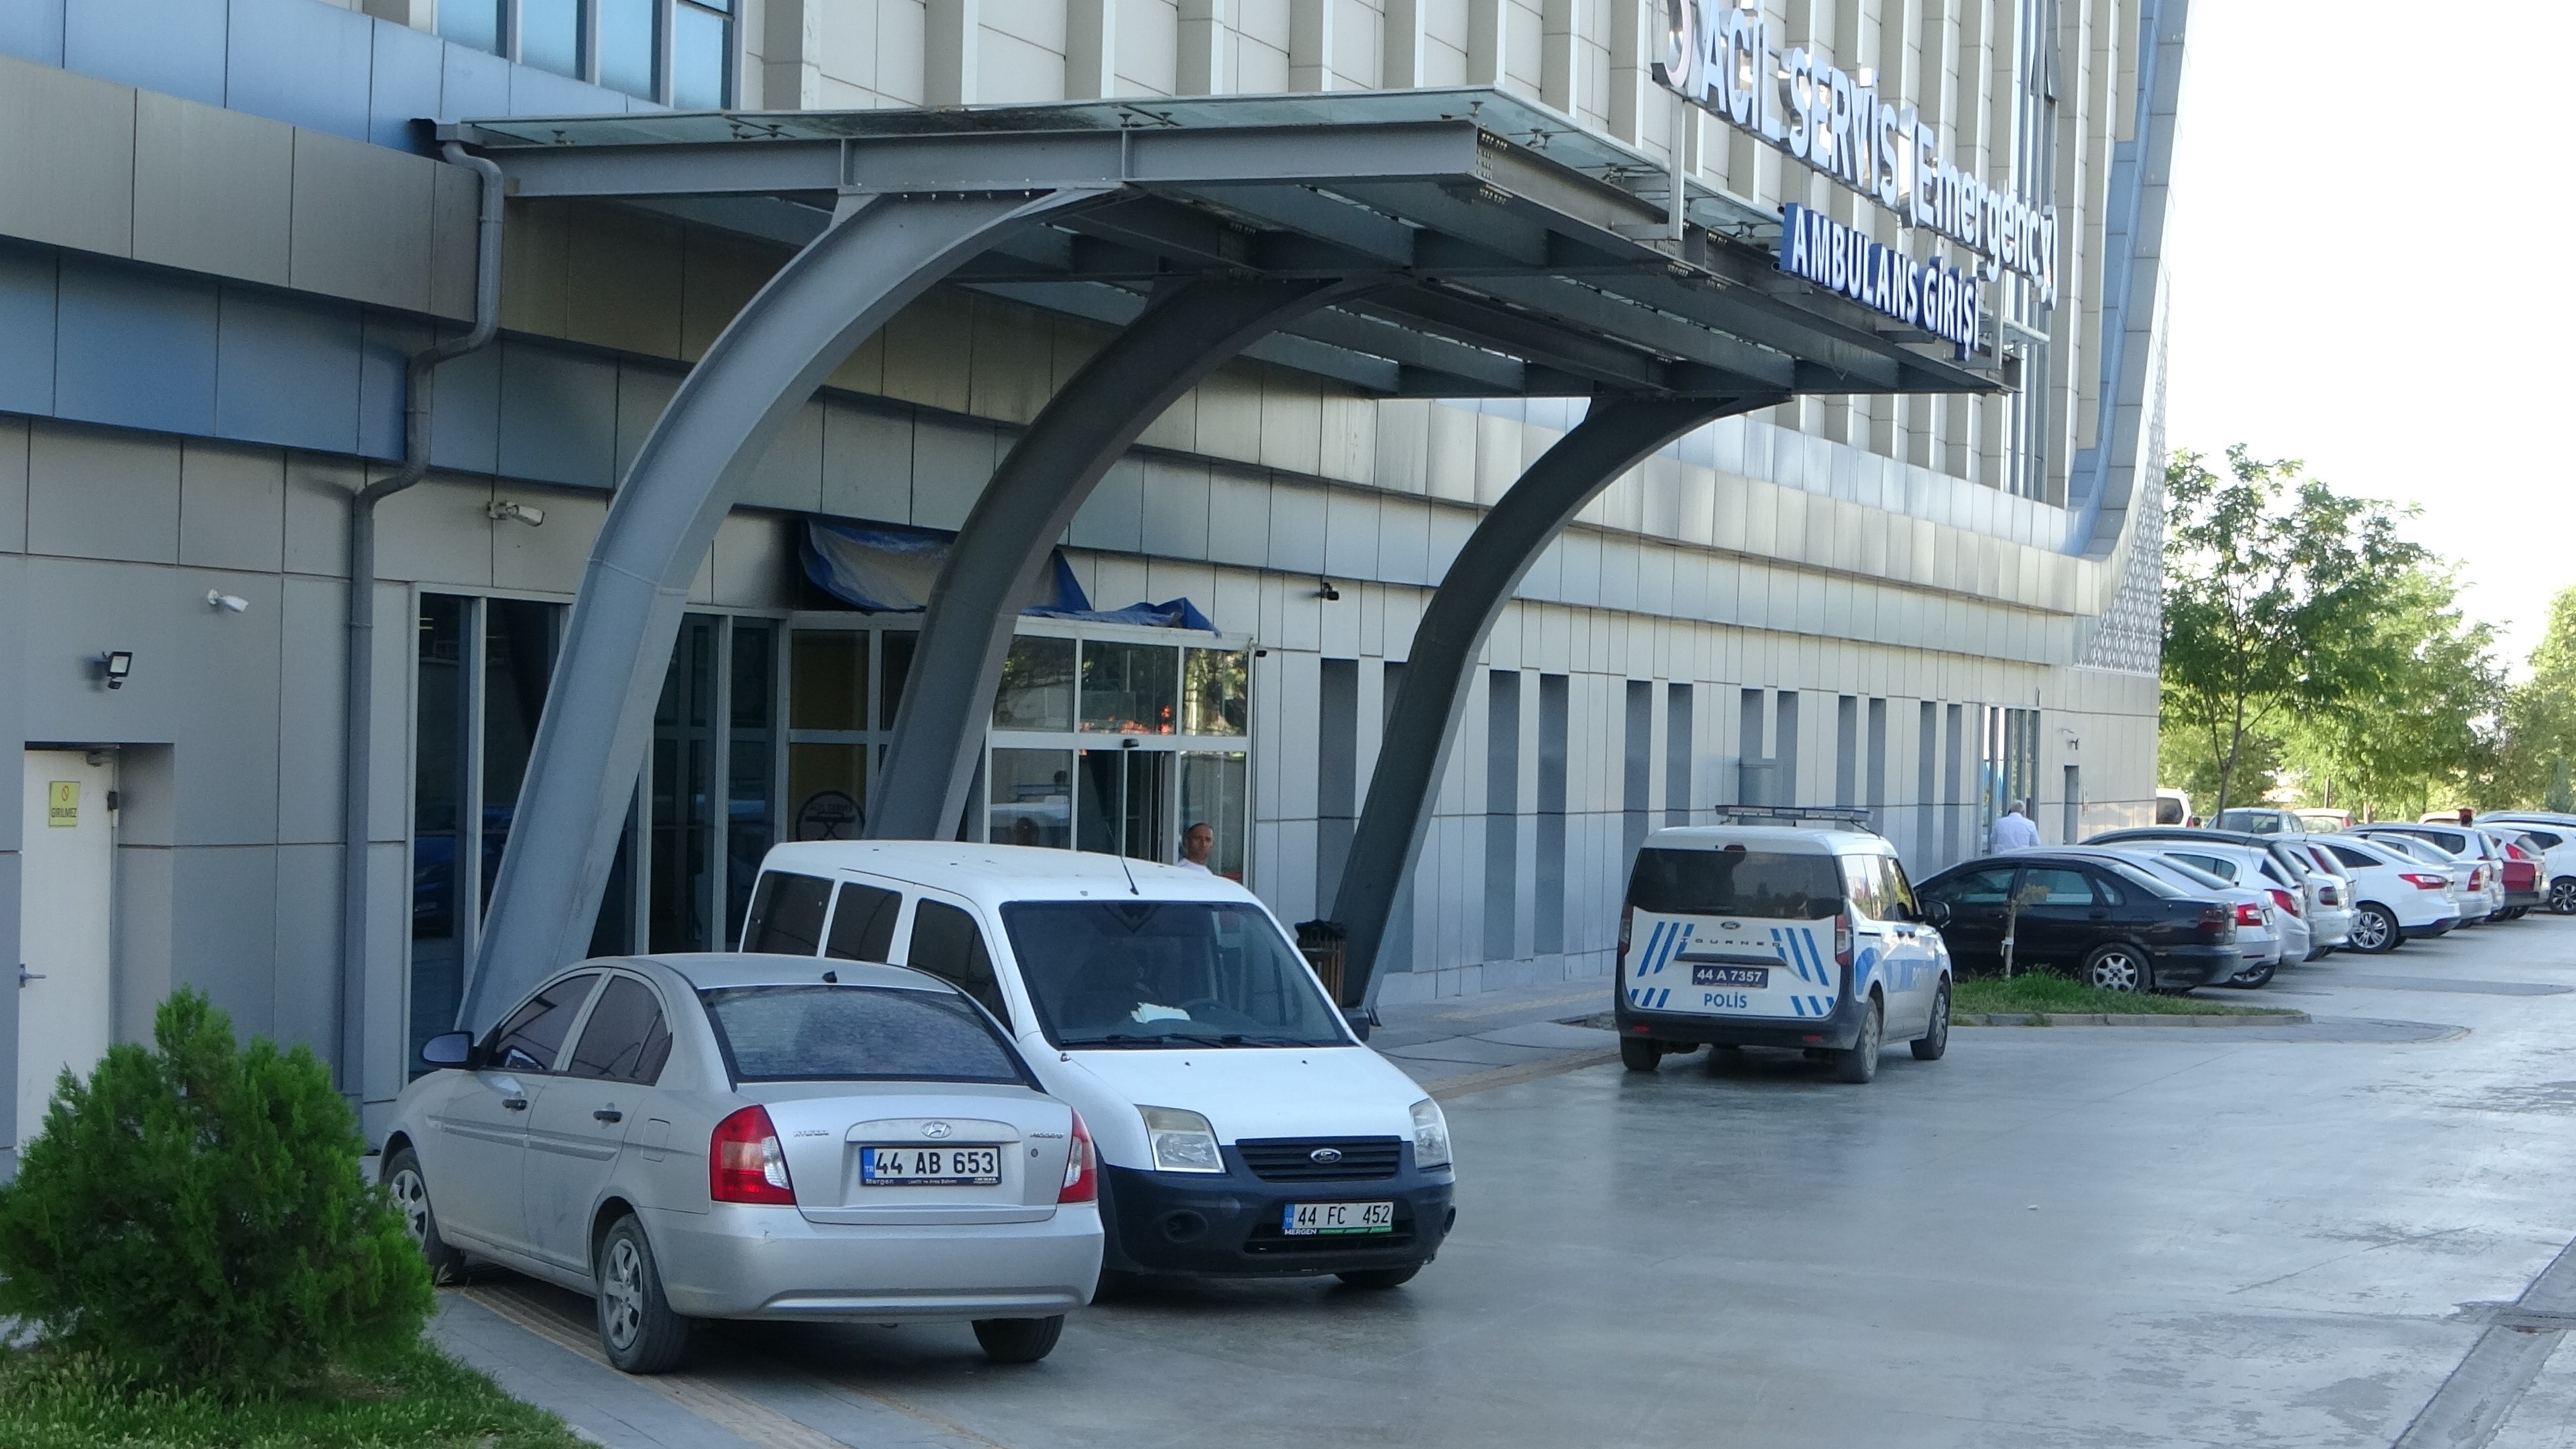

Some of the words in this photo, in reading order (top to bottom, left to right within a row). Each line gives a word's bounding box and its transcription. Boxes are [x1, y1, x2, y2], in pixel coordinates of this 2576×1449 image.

[1789, 46, 1897, 207] SERVİS
[1909, 107, 2058, 311] (Emergency)
[1791, 203, 1918, 325] AMBULANS
[1923, 256, 1980, 362] GİRİŞİ
[51, 805, 77, 818] GİRİLMEZ
[1681, 938, 1780, 947] TOURNEO
[1697, 969, 1713, 981] 44
[1716, 970, 1727, 981] A
[1730, 971, 1762, 982] 7357
[1704, 991, 1748, 1008] POLİS
[875, 1152, 903, 1175] 44
[915, 1152, 941, 1175] AB
[953, 1152, 994, 1175] 653
[1298, 1207, 1317, 1225] 44
[1328, 1206, 1346, 1225] FC
[1362, 1205, 1390, 1224] 452
